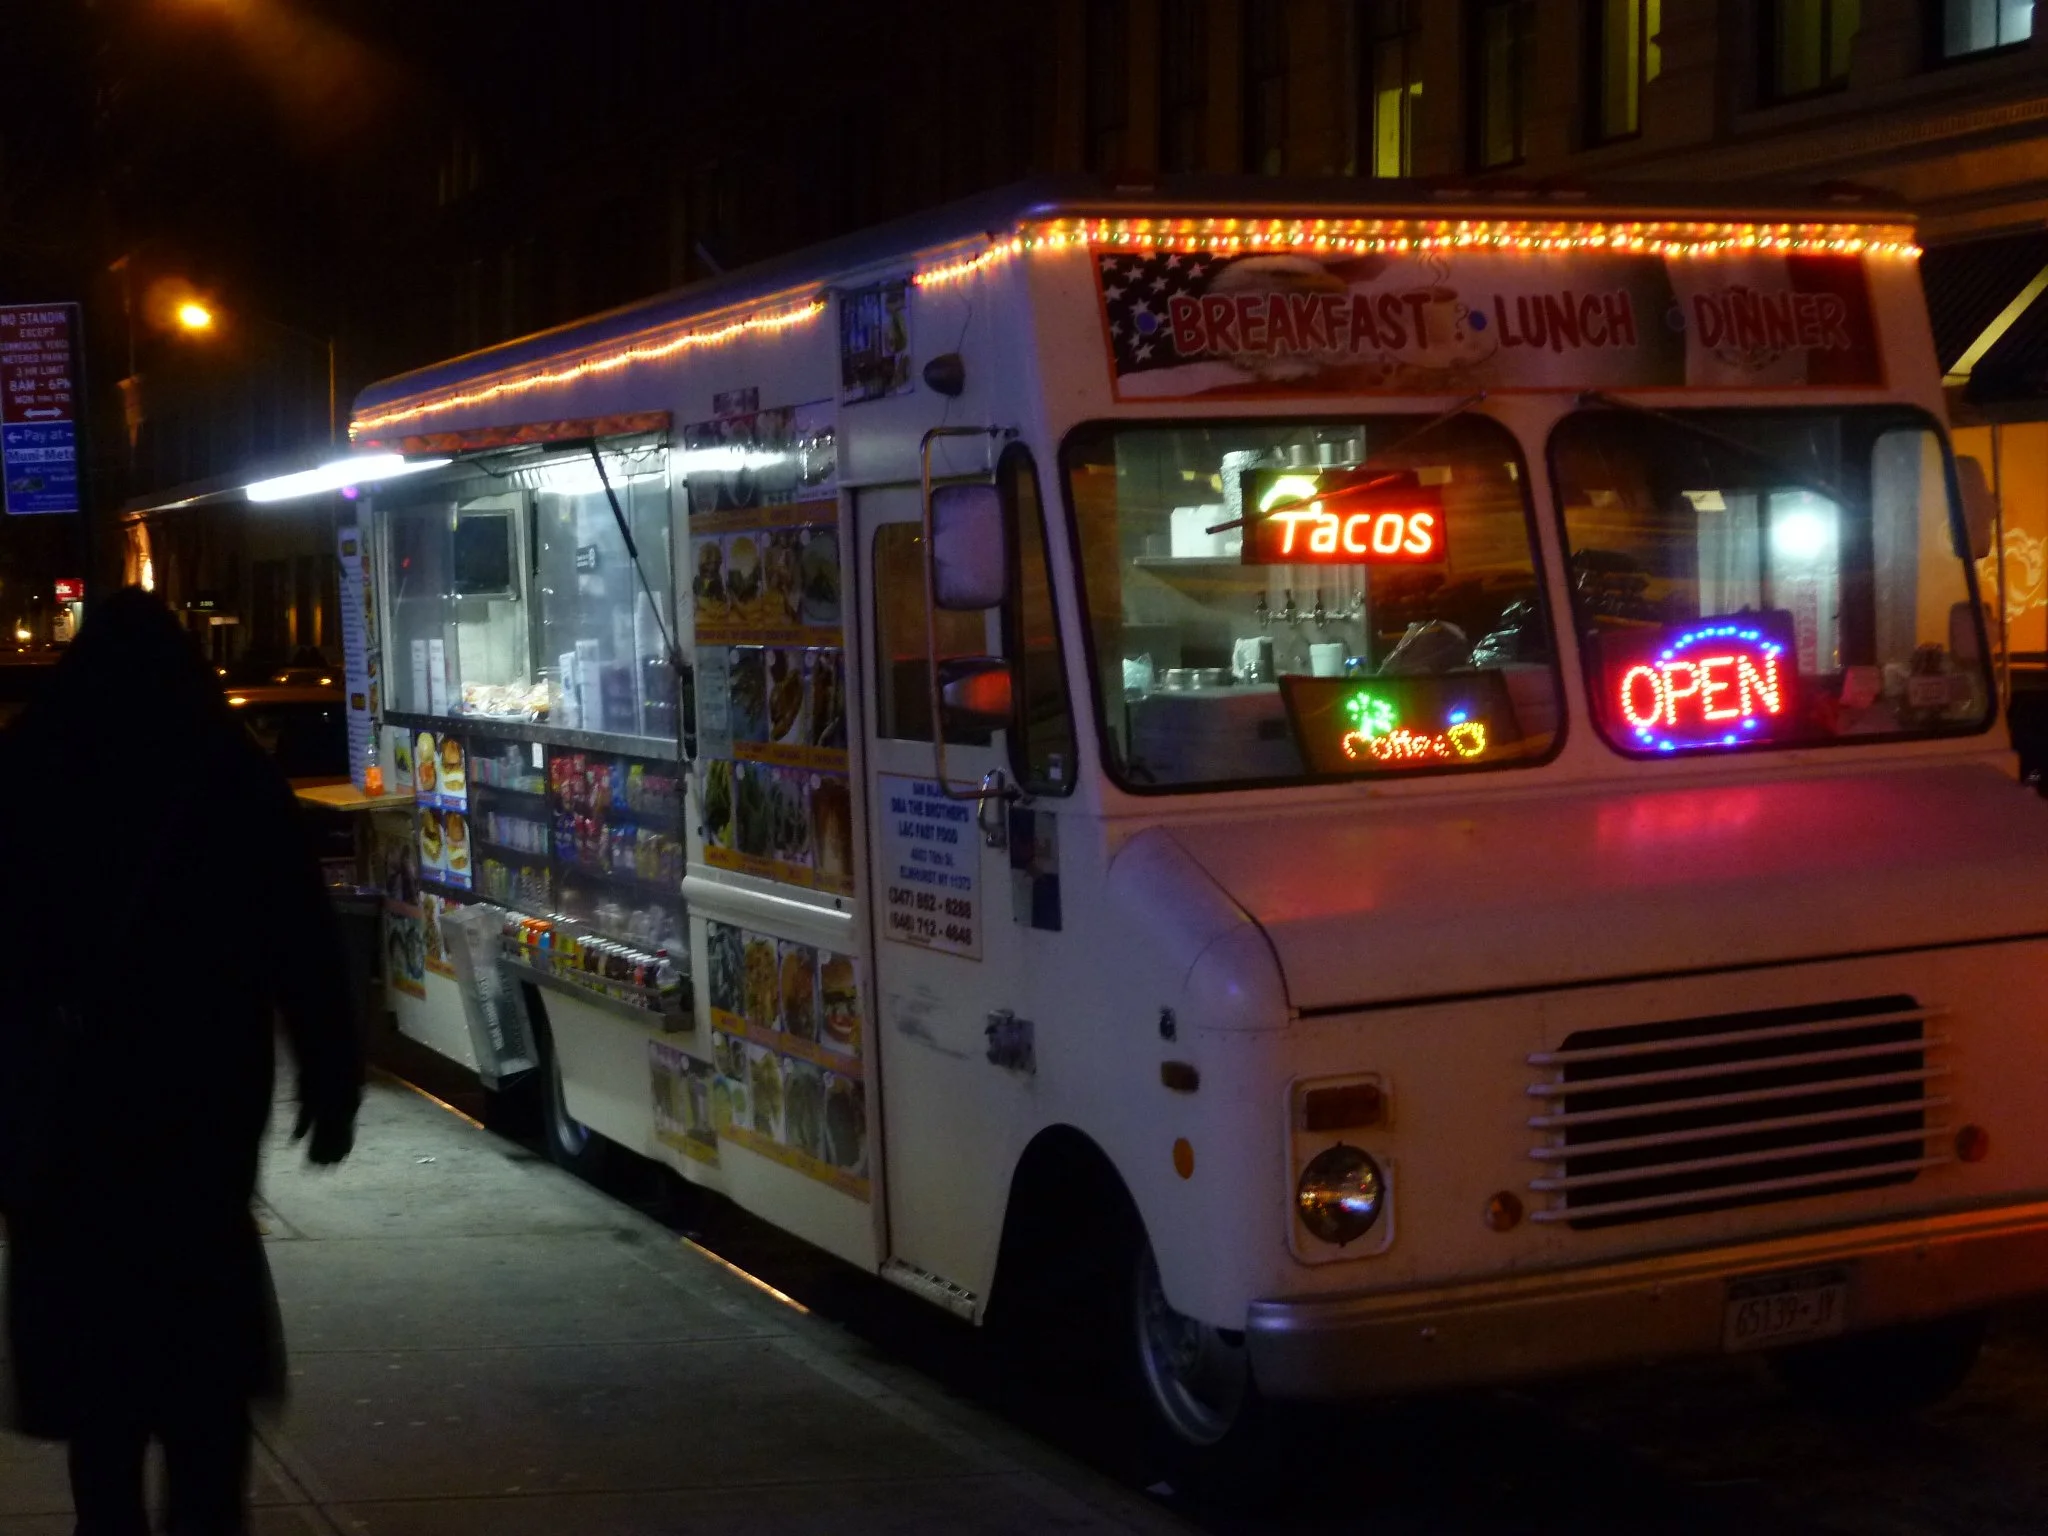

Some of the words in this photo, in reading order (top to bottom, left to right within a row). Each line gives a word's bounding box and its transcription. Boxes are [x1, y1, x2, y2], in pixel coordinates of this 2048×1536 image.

[0, 313, 16, 325] NO
[20, 311, 66, 325] STANDIN
[1169, 292, 1431, 355] BREAKFAST
[1494, 290, 1635, 353] LUNCH
[1693, 288, 1850, 351] DINNER
[20, 327, 55, 338] EXCEPT
[9, 379, 35, 391] 8AM
[23, 429, 46, 444] Pay
[50, 429, 64, 440] at
[1268, 511, 1434, 555] Tacos
[1621, 653, 1781, 727] OPEN
[1343, 729, 1451, 760] Coffee
